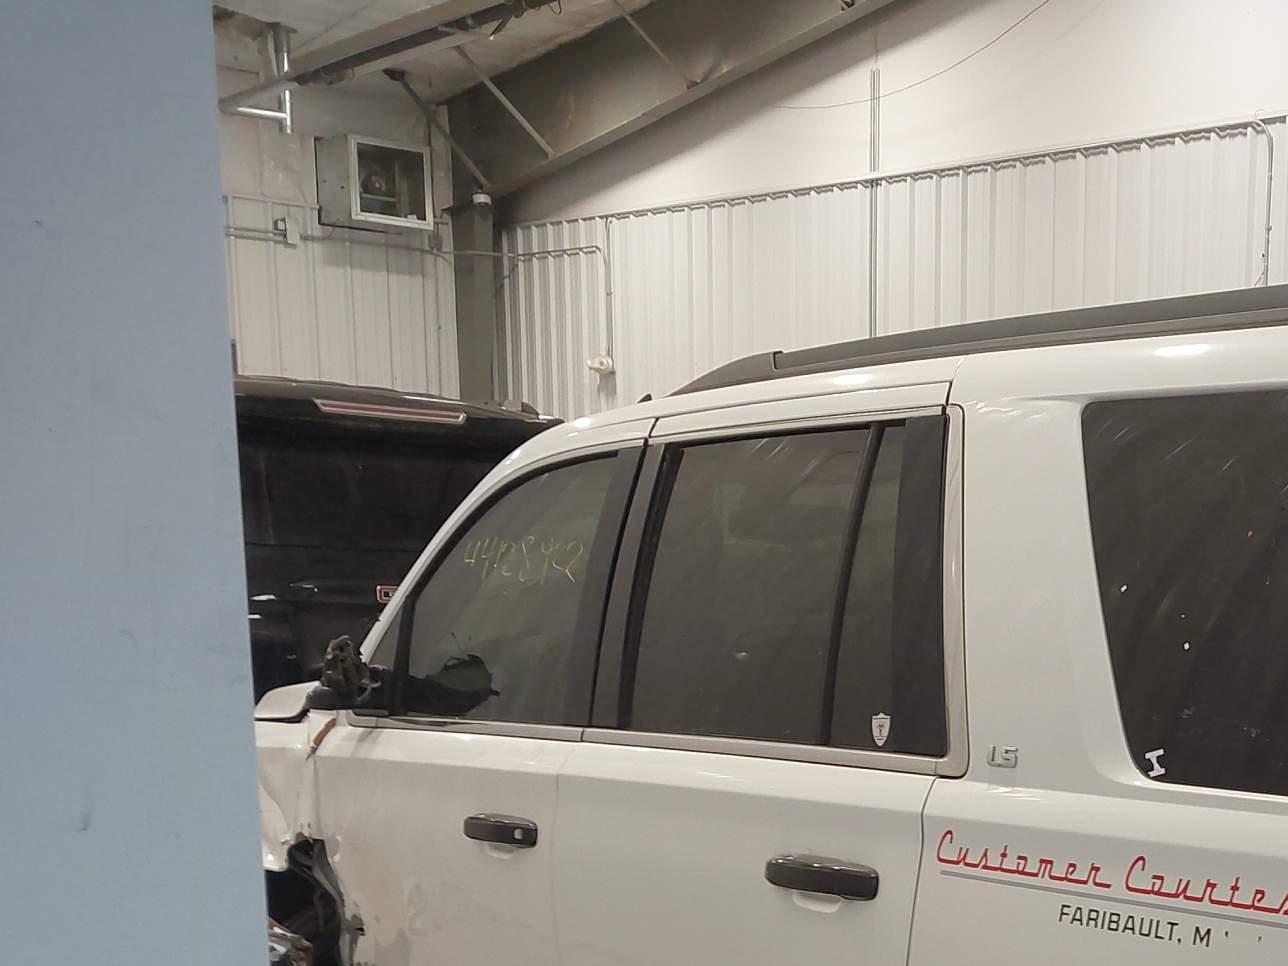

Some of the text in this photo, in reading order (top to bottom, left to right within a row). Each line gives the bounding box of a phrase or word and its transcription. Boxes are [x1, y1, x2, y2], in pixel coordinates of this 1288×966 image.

[987, 745, 1018, 768] LS
[936, 829, 1112, 889] Customer
[1058, 903, 1183, 945] FARIBAULT,
